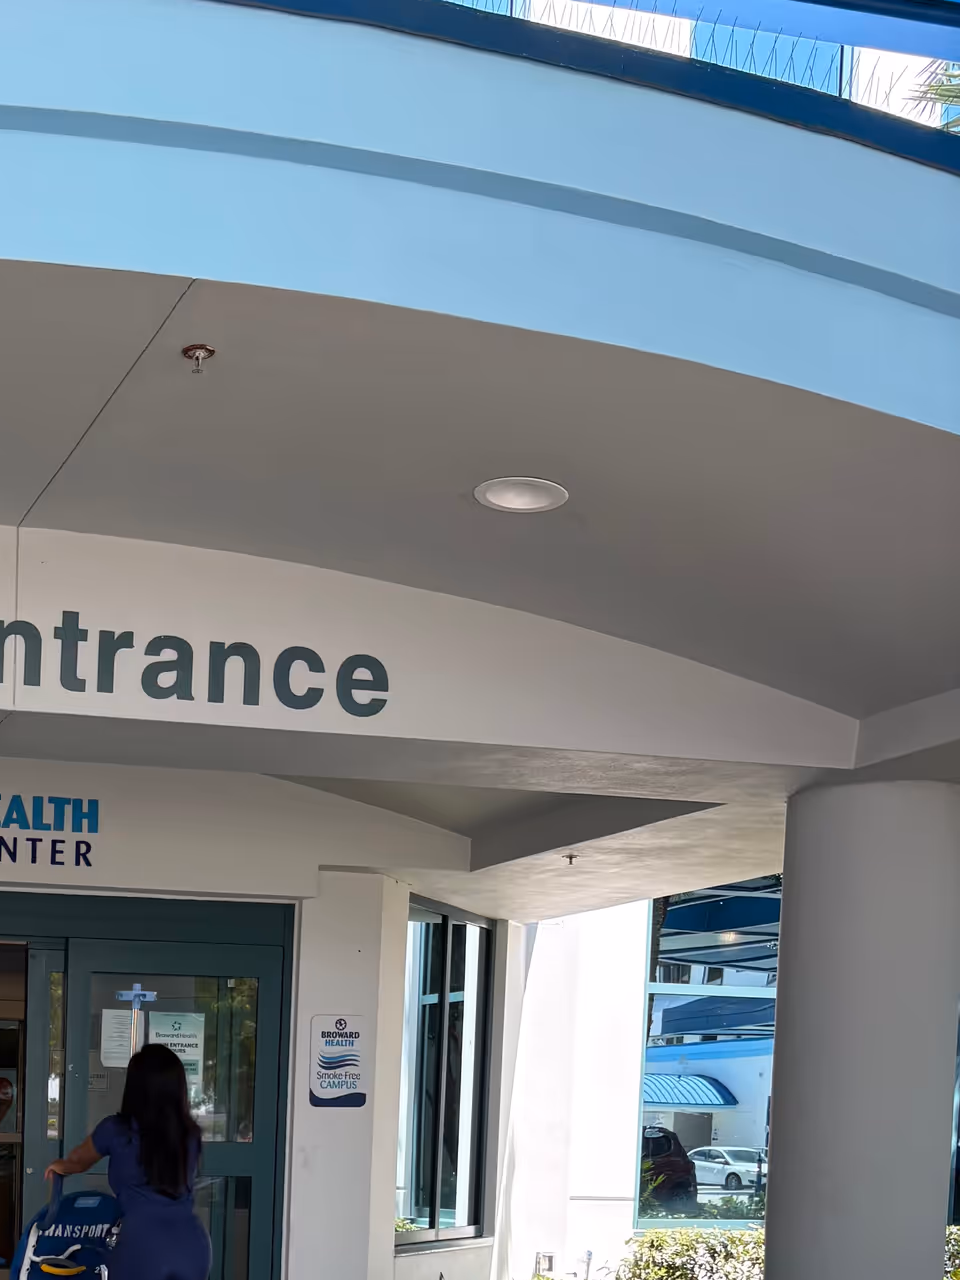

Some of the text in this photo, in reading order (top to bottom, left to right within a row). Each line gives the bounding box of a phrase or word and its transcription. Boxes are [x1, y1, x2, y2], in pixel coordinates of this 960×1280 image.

[321, 1031, 360, 1039] BROWARD
[324, 1039, 354, 1047] HEALTH
[316, 1071, 360, 1080] Smoke-Free
[320, 1080, 357, 1089] CAMPUS
